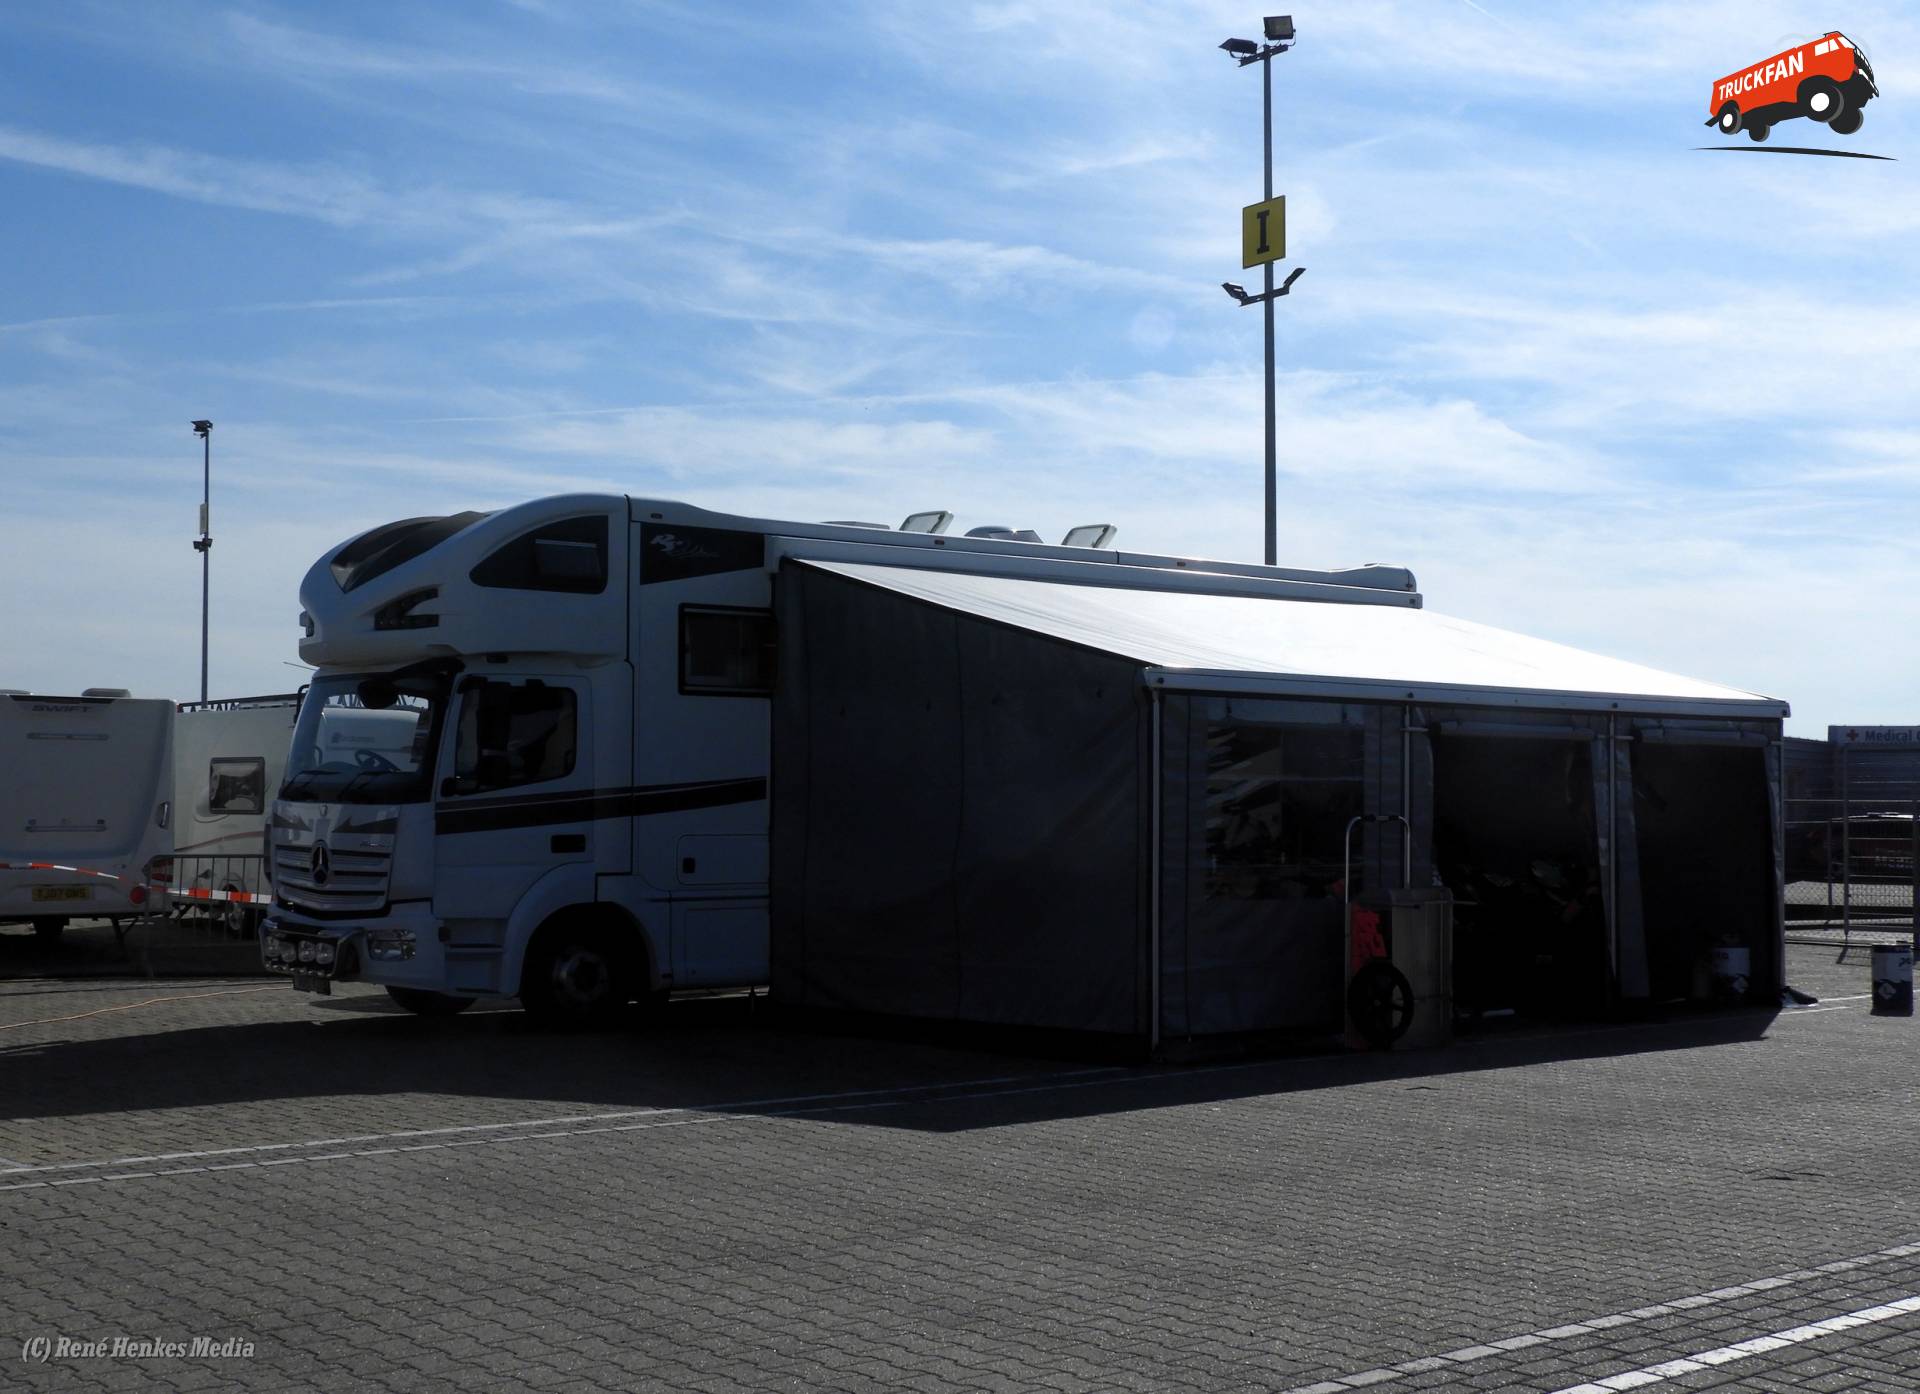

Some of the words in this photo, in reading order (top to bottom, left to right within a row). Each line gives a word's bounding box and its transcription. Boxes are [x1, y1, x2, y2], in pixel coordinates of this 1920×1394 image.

[1257, 210, 1270, 254] I
[32, 704, 91, 713] SWIFT
[1865, 728, 1912, 741] Medical
